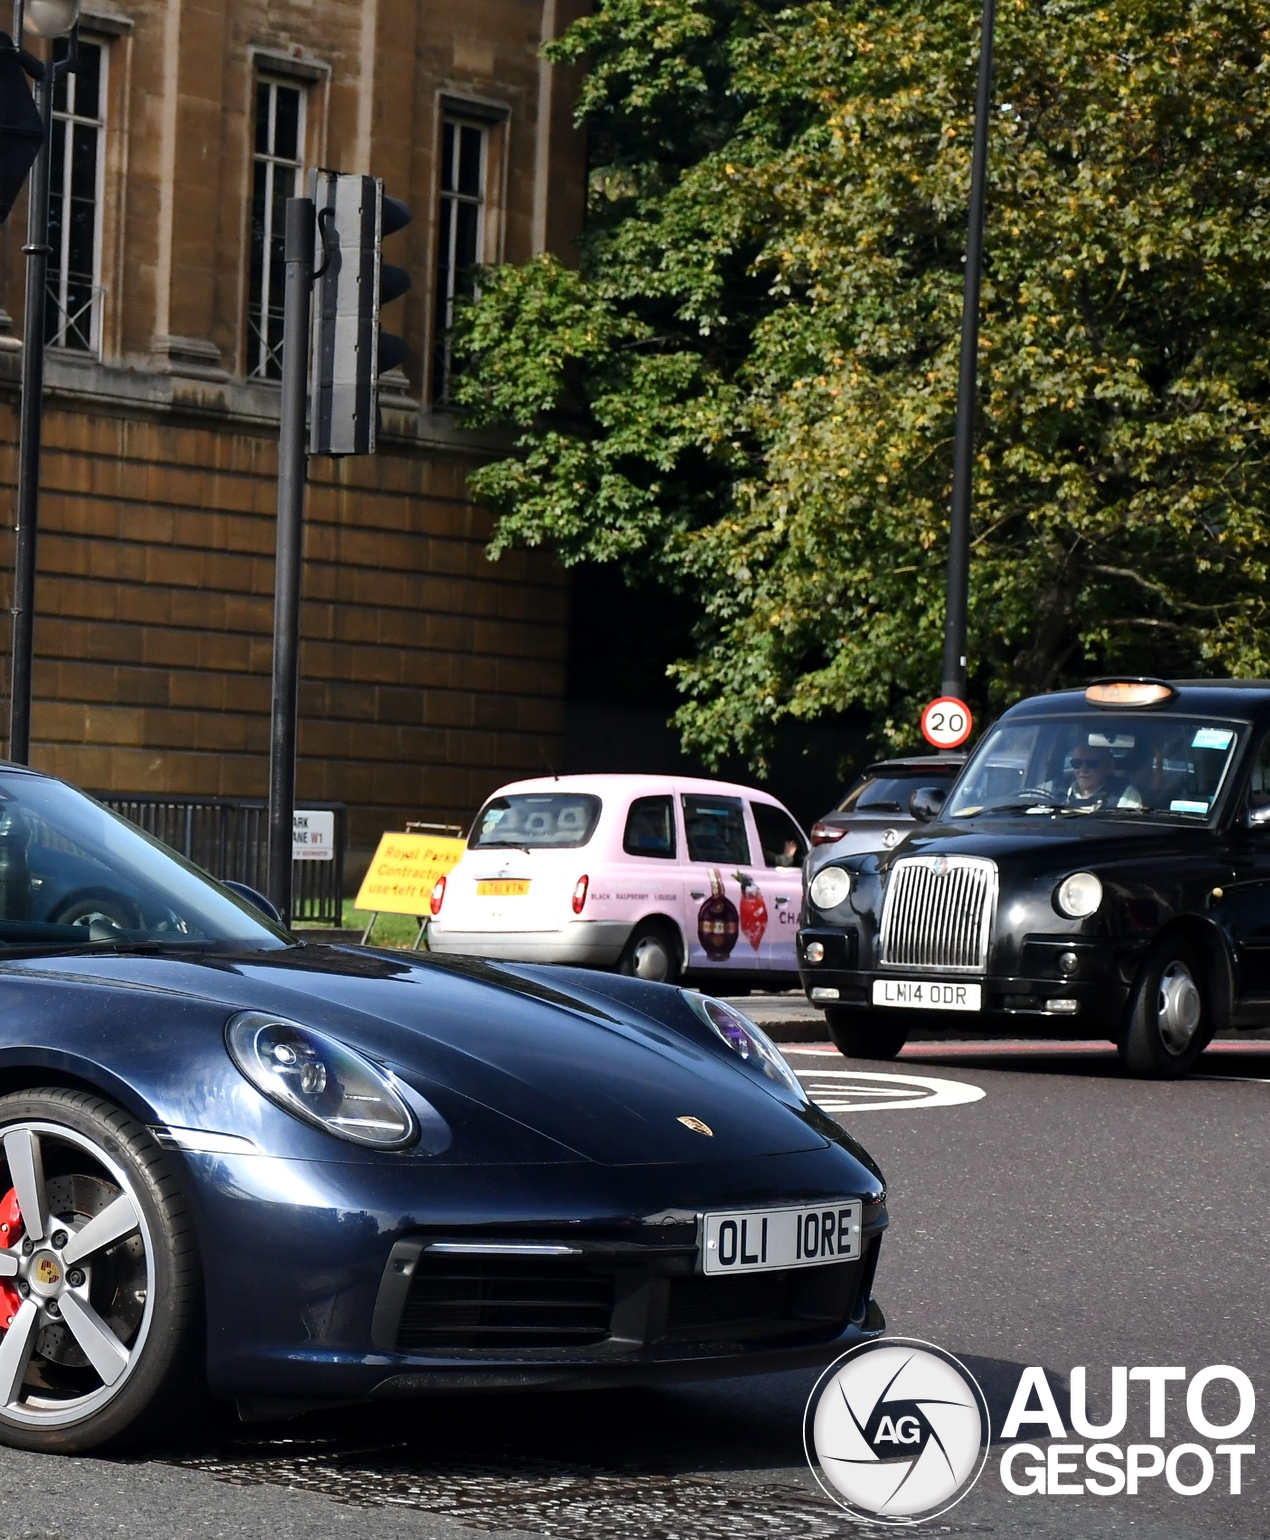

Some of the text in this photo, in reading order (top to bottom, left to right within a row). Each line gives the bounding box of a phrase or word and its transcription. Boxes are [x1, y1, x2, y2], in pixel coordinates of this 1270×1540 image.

[931, 712, 964, 732] 20
[293, 817, 309, 828] ARK
[293, 832, 323, 844] ANE W1
[385, 846, 459, 864] Royal Parks
[368, 884, 391, 895] use
[392, 885, 416, 897] left
[885, 982, 967, 1005] LM14 ODR
